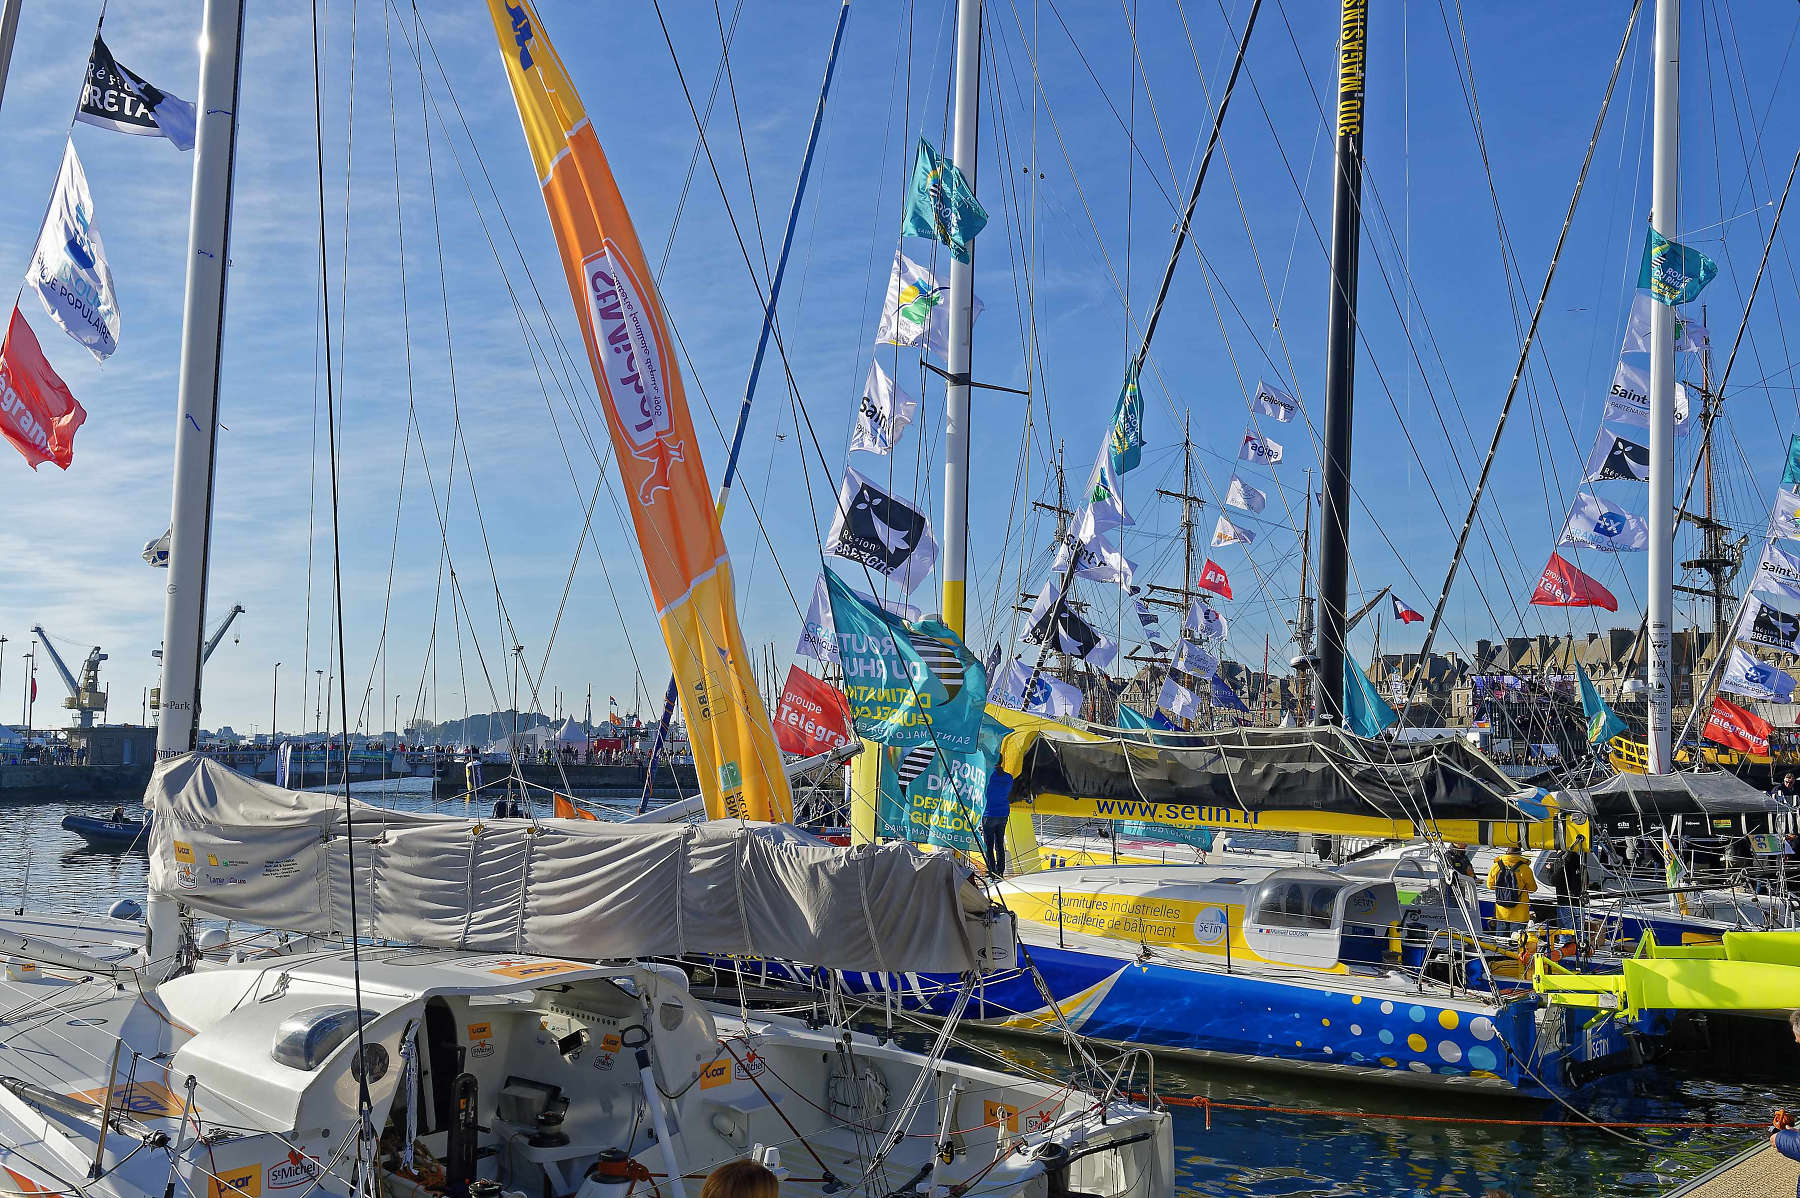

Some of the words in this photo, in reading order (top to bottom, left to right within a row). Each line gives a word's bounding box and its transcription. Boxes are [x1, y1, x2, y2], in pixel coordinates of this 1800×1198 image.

[59, 285, 112, 345] POPULAIRE
[1259, 391, 1295, 412] Fellowes
[1250, 442, 1279, 460] agipa
[169, 700, 192, 710] Park
[785, 691, 823, 715] groupe
[1051, 893, 1108, 911] Fournitures
[1110, 897, 1181, 920] industrielles
[1044, 909, 1106, 929] Quincaillerie
[1107, 916, 1121, 931] de
[1123, 919, 1177, 939] bâtiment
[219, 1174, 253, 1193] ucar
